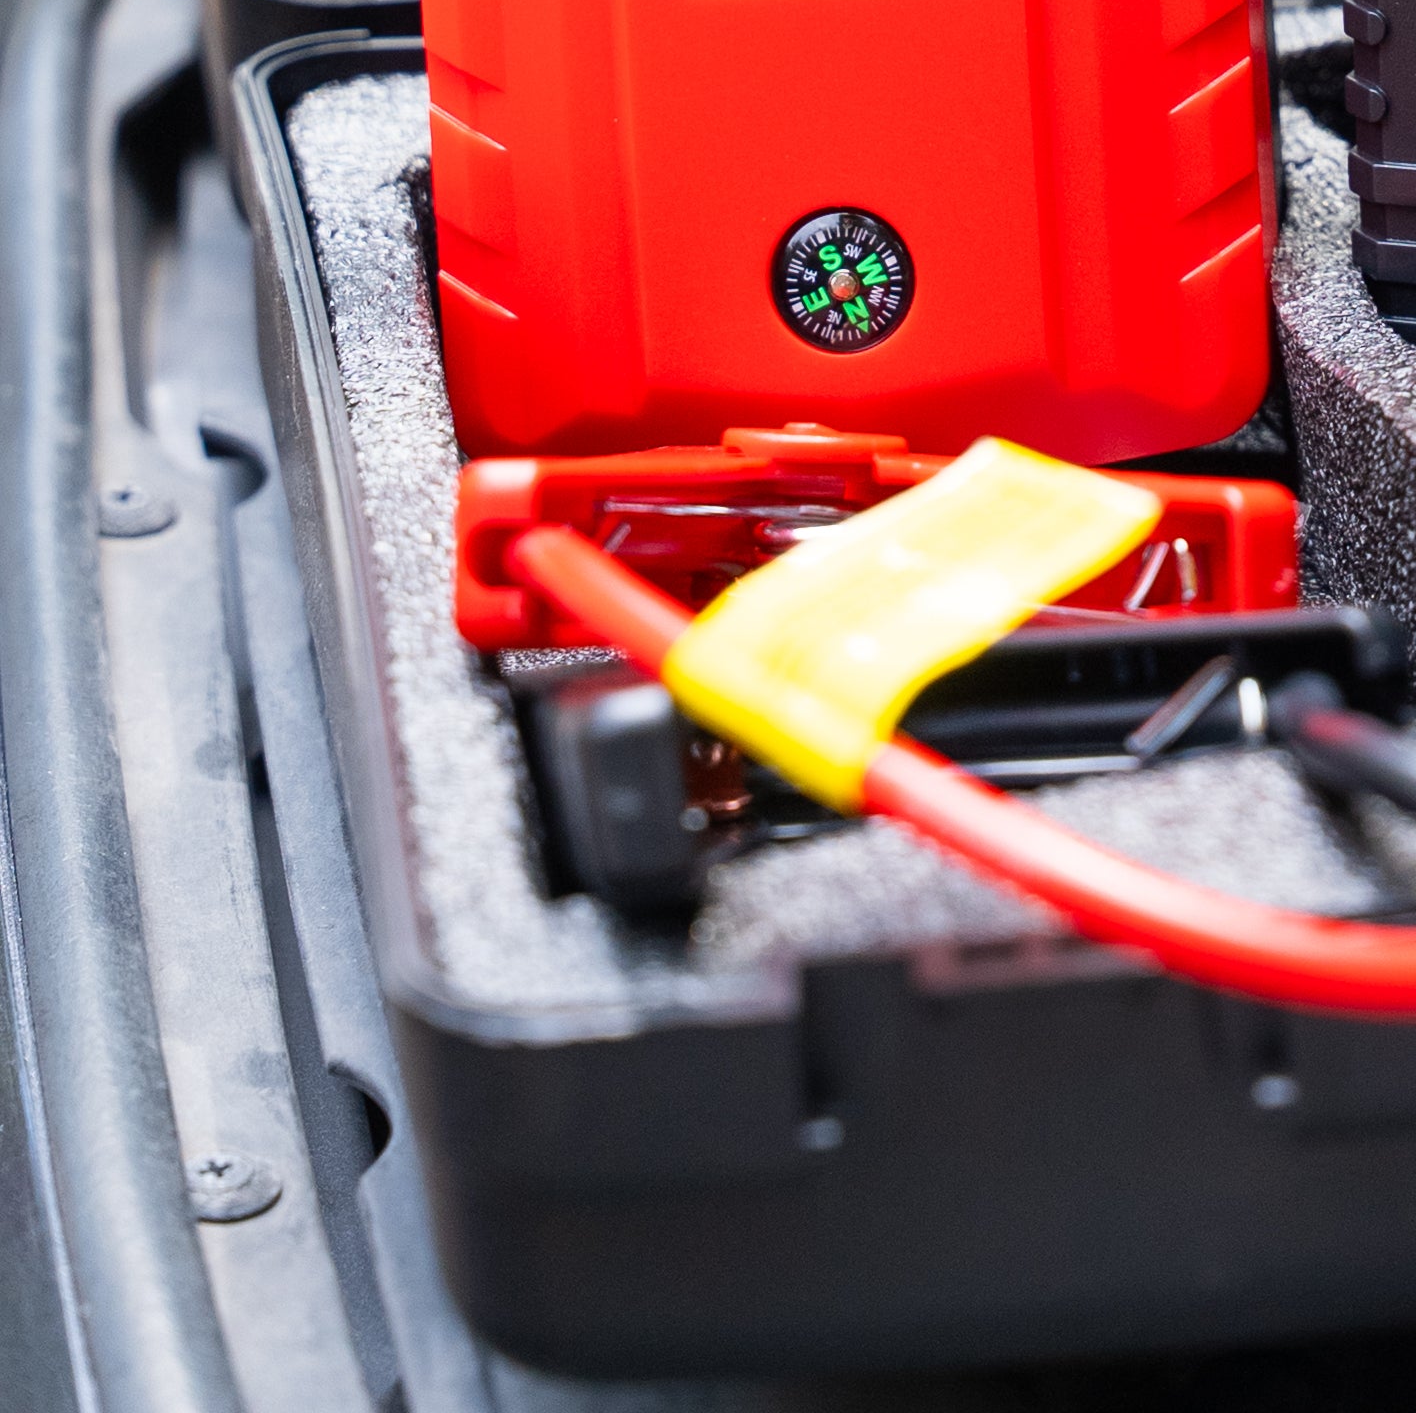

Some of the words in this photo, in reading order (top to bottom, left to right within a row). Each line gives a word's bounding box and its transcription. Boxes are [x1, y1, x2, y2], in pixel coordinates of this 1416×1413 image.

[818, 244, 843, 271] S
[843, 243, 862, 259] SW
[803, 268, 818, 283] SE
[856, 253, 888, 286] W
[802, 286, 831, 313] E
[868, 285, 885, 306] NW
[826, 310, 842, 325] NE
[842, 296, 870, 324] N
